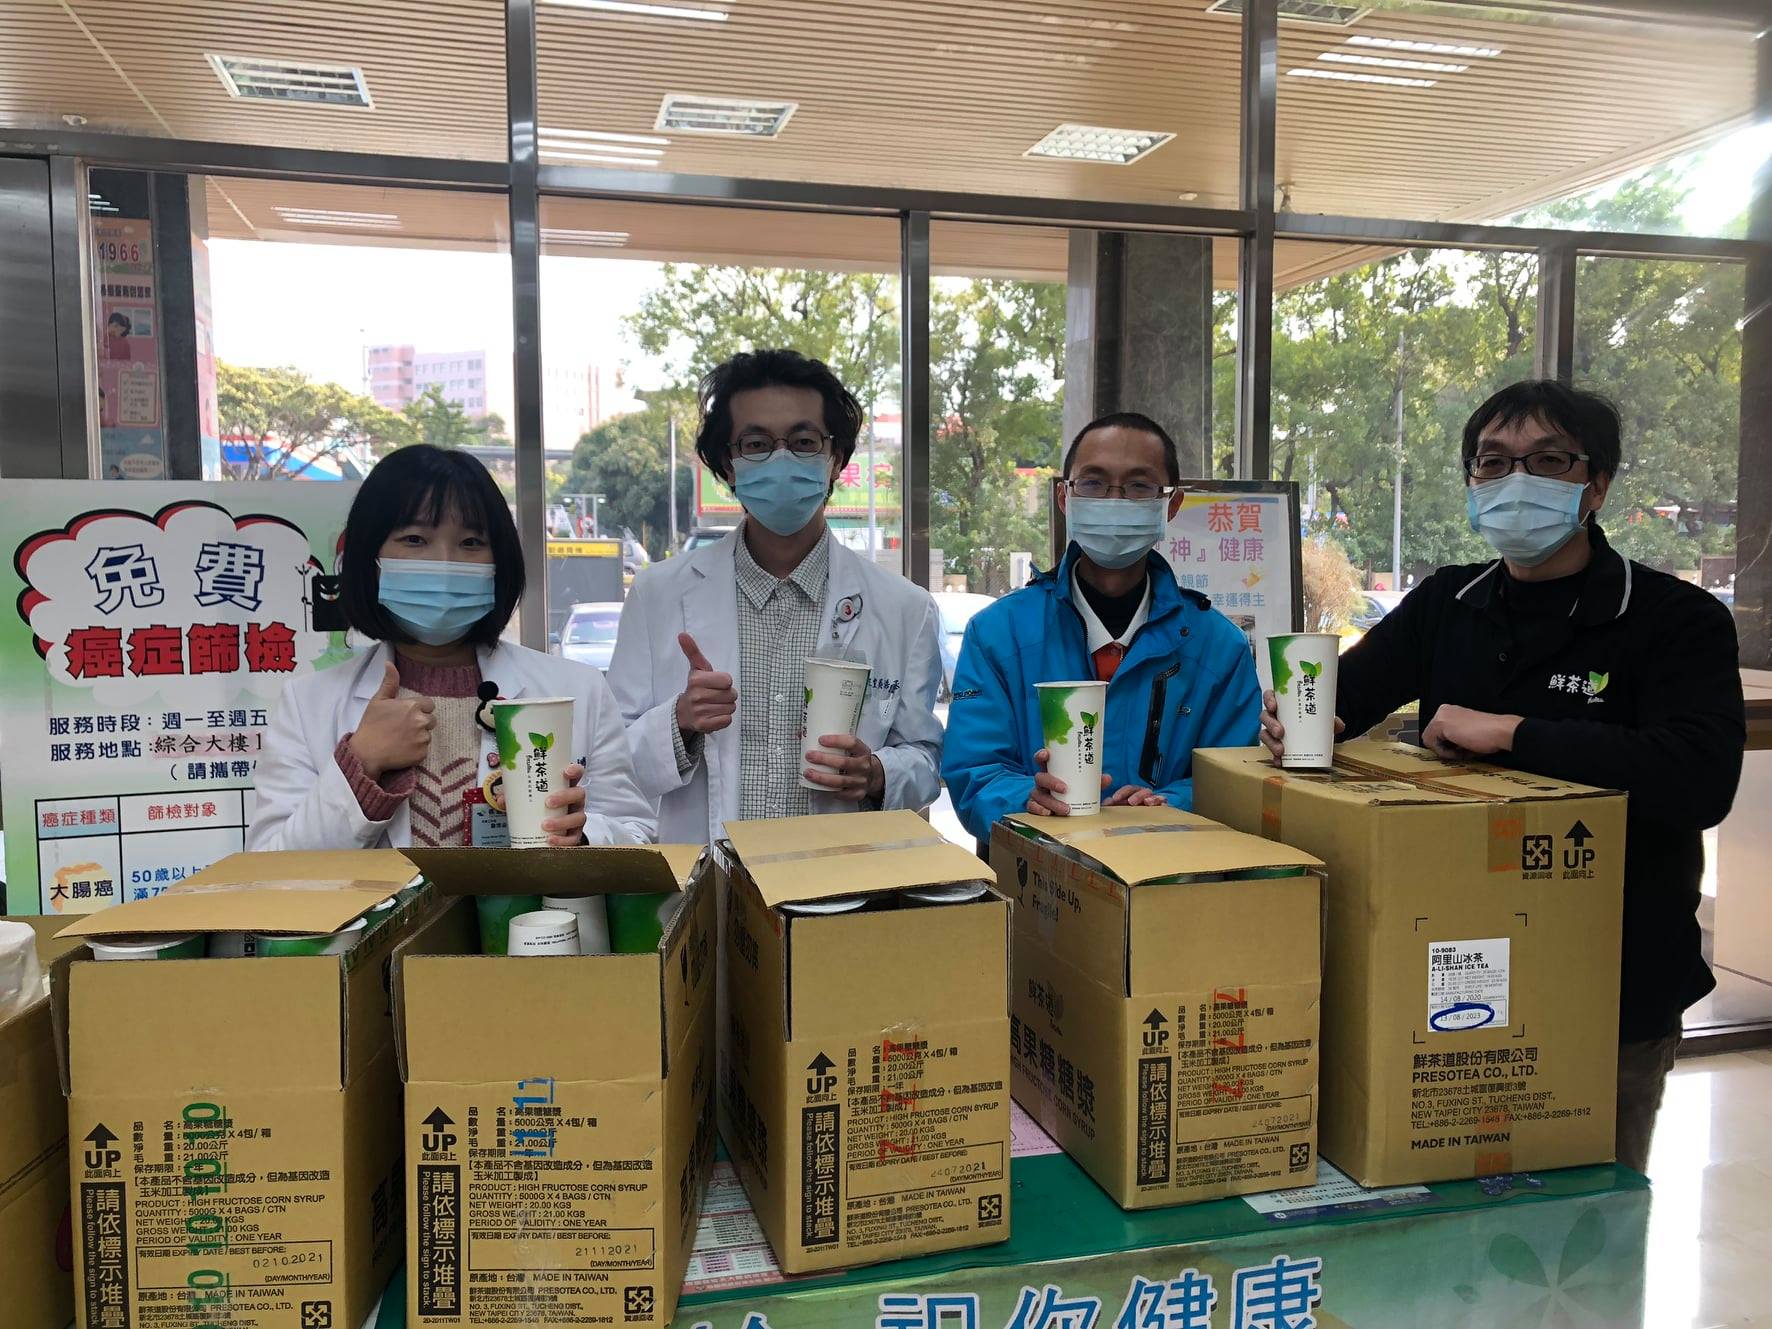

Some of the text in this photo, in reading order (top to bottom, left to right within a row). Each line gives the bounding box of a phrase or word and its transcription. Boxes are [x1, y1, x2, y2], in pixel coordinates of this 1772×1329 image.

[100, 242, 139, 262] 1966
[1208, 503, 1263, 533] 恭賀
[84, 542, 265, 615] 免費
[1177, 574, 1209, 588] 親節
[64, 621, 298, 680] 癌症篩檢
[1303, 674, 1317, 715] 鮮茶道
[1083, 724, 1094, 765] 鮮茶道
[533, 746, 549, 793] 鮮茶道
[42, 808, 115, 828] 癌症種類
[147, 801, 217, 821] 篩檢對象
[1564, 849, 1595, 869] UP
[50, 880, 114, 901] 大腸癌
[1431, 952, 1484, 966] 阿里山冰茶
[1431, 964, 1463, 972] A-LI-SHAN
[1143, 1030, 1169, 1047] UP
[1413, 1047, 1538, 1070] 鮮茶道股份有限公司
[1412, 1065, 1538, 1083] PRESOTEA CO., LTD.
[806, 1075, 837, 1094] UP
[1411, 1110, 1432, 1119] NEW
[1434, 1108, 1461, 1118] TAIPEI
[1462, 1106, 1482, 1116] CITY
[1512, 1102, 1545, 1111] TAIWAN
[1436, 1098, 1469, 1108] FUXING
[1488, 1094, 1531, 1104] TUCHENG
[847, 1102, 999, 1127] PRODUCT HIGH FRUCTOSE CORN SYRUP
[1148, 1063, 1167, 1179] 請依標示堆疊
[422, 1133, 457, 1152] UP
[1223, 1139, 1244, 1148] MADE
[1254, 1136, 1280, 1144] TAIWAN
[1411, 1132, 1511, 1150] MADE IN TAIWAN
[84, 1150, 122, 1169] UP
[814, 1111, 835, 1239] 請依標示堆疊
[422, 1171, 431, 1201] Please
[469, 1184, 648, 1192] PRODUCT HIGH FRUCTOSE CORN SYRUP
[901, 1192, 925, 1202] MADE
[936, 1186, 966, 1197] TAIWAN
[135, 1194, 325, 1208] PRODUCT HIGH FRUCTOSE CORN SYRUP
[422, 1203, 431, 1232] follow
[469, 1210, 585, 1218] GROSS WEIGHT 21.00 KGS
[469, 1219, 502, 1227] PERIOD
[504, 1219, 516, 1227] OF
[563, 1219, 583, 1227] ONE
[584, 1219, 607, 1227] YEAR
[422, 1232, 431, 1247] the
[432, 1171, 456, 1309] 請依標示堆疊
[532, 1232, 552, 1240] DATE
[557, 1232, 576, 1240] BEST
[578, 1232, 611, 1240] BEFORE:
[96, 1189, 125, 1328] 請依標示堆疊
[421, 1248, 430, 1268] sign
[575, 1244, 637, 1257] 21112021
[423, 1270, 430, 1280] to
[235, 1288, 285, 1298] IN TAIWAN
[582, 1287, 598, 1295] CO.,
[210, 1303, 256, 1312] PRESOTEA
[275, 1302, 294, 1310] LTD.
